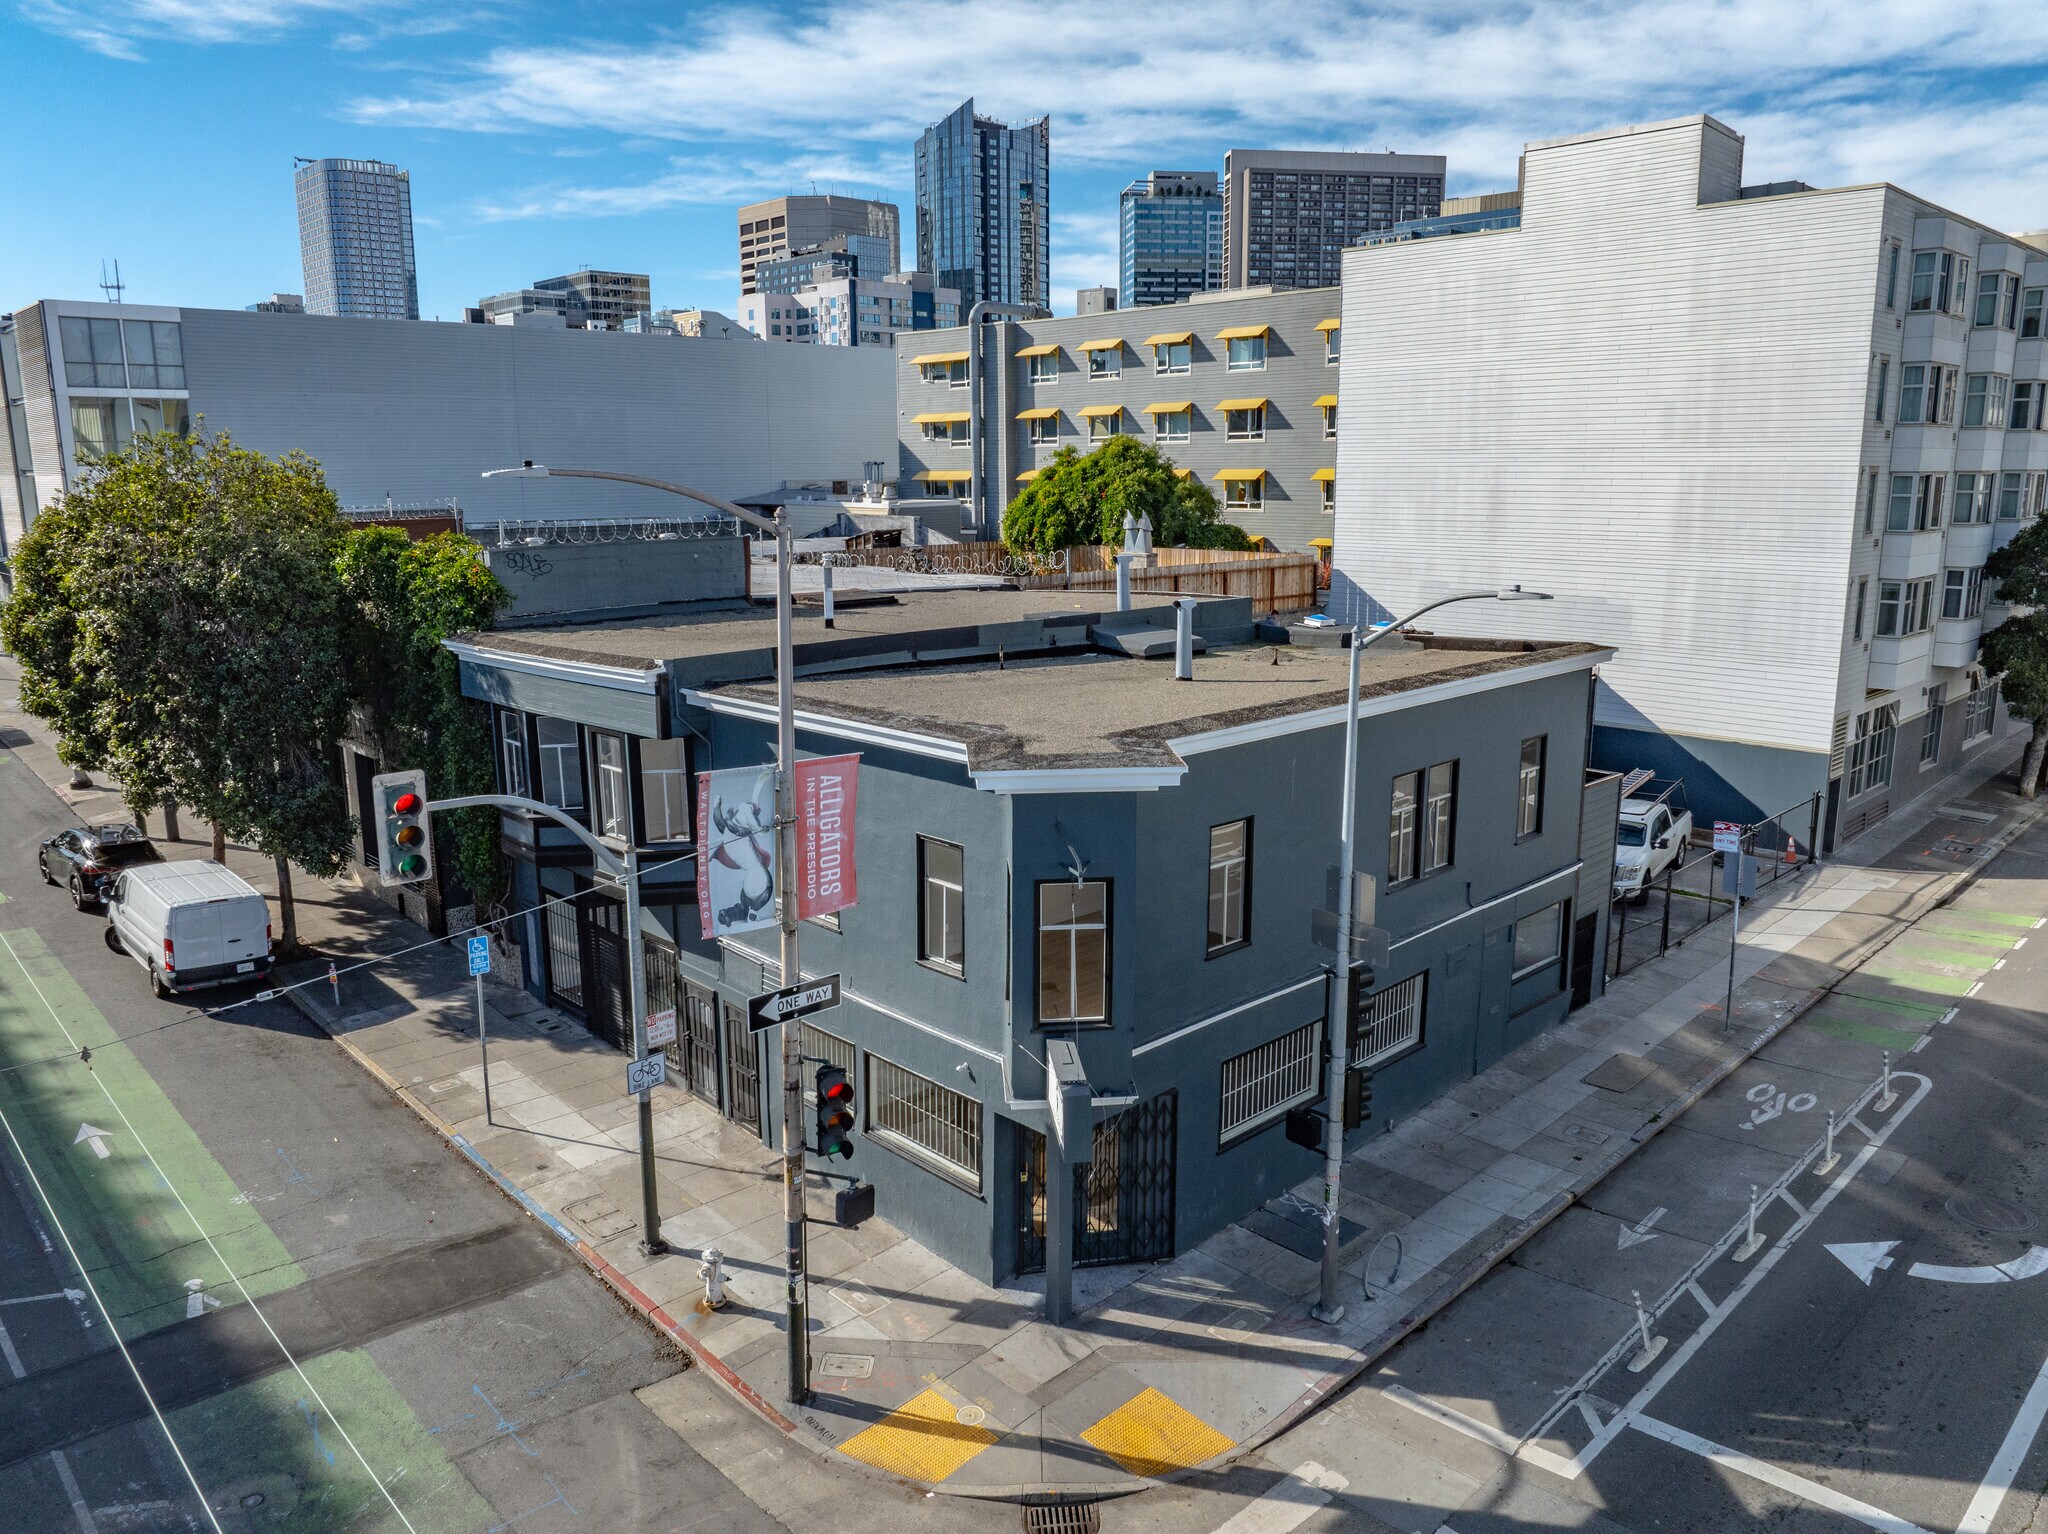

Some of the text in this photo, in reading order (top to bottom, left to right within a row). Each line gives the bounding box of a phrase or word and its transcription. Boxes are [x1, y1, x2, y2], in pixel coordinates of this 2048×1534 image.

[806, 777, 817, 900] IN THE PRESIDIO
[820, 775, 841, 896] ALLIGATORS
[699, 790, 711, 918] WALTDISNEY.ORG
[777, 986, 829, 1013] ONE WAY
[647, 1013, 674, 1027] NO PARKING
[634, 1076, 661, 1091] BIKE LANE
[805, 1416, 837, 1442] HOWARD
